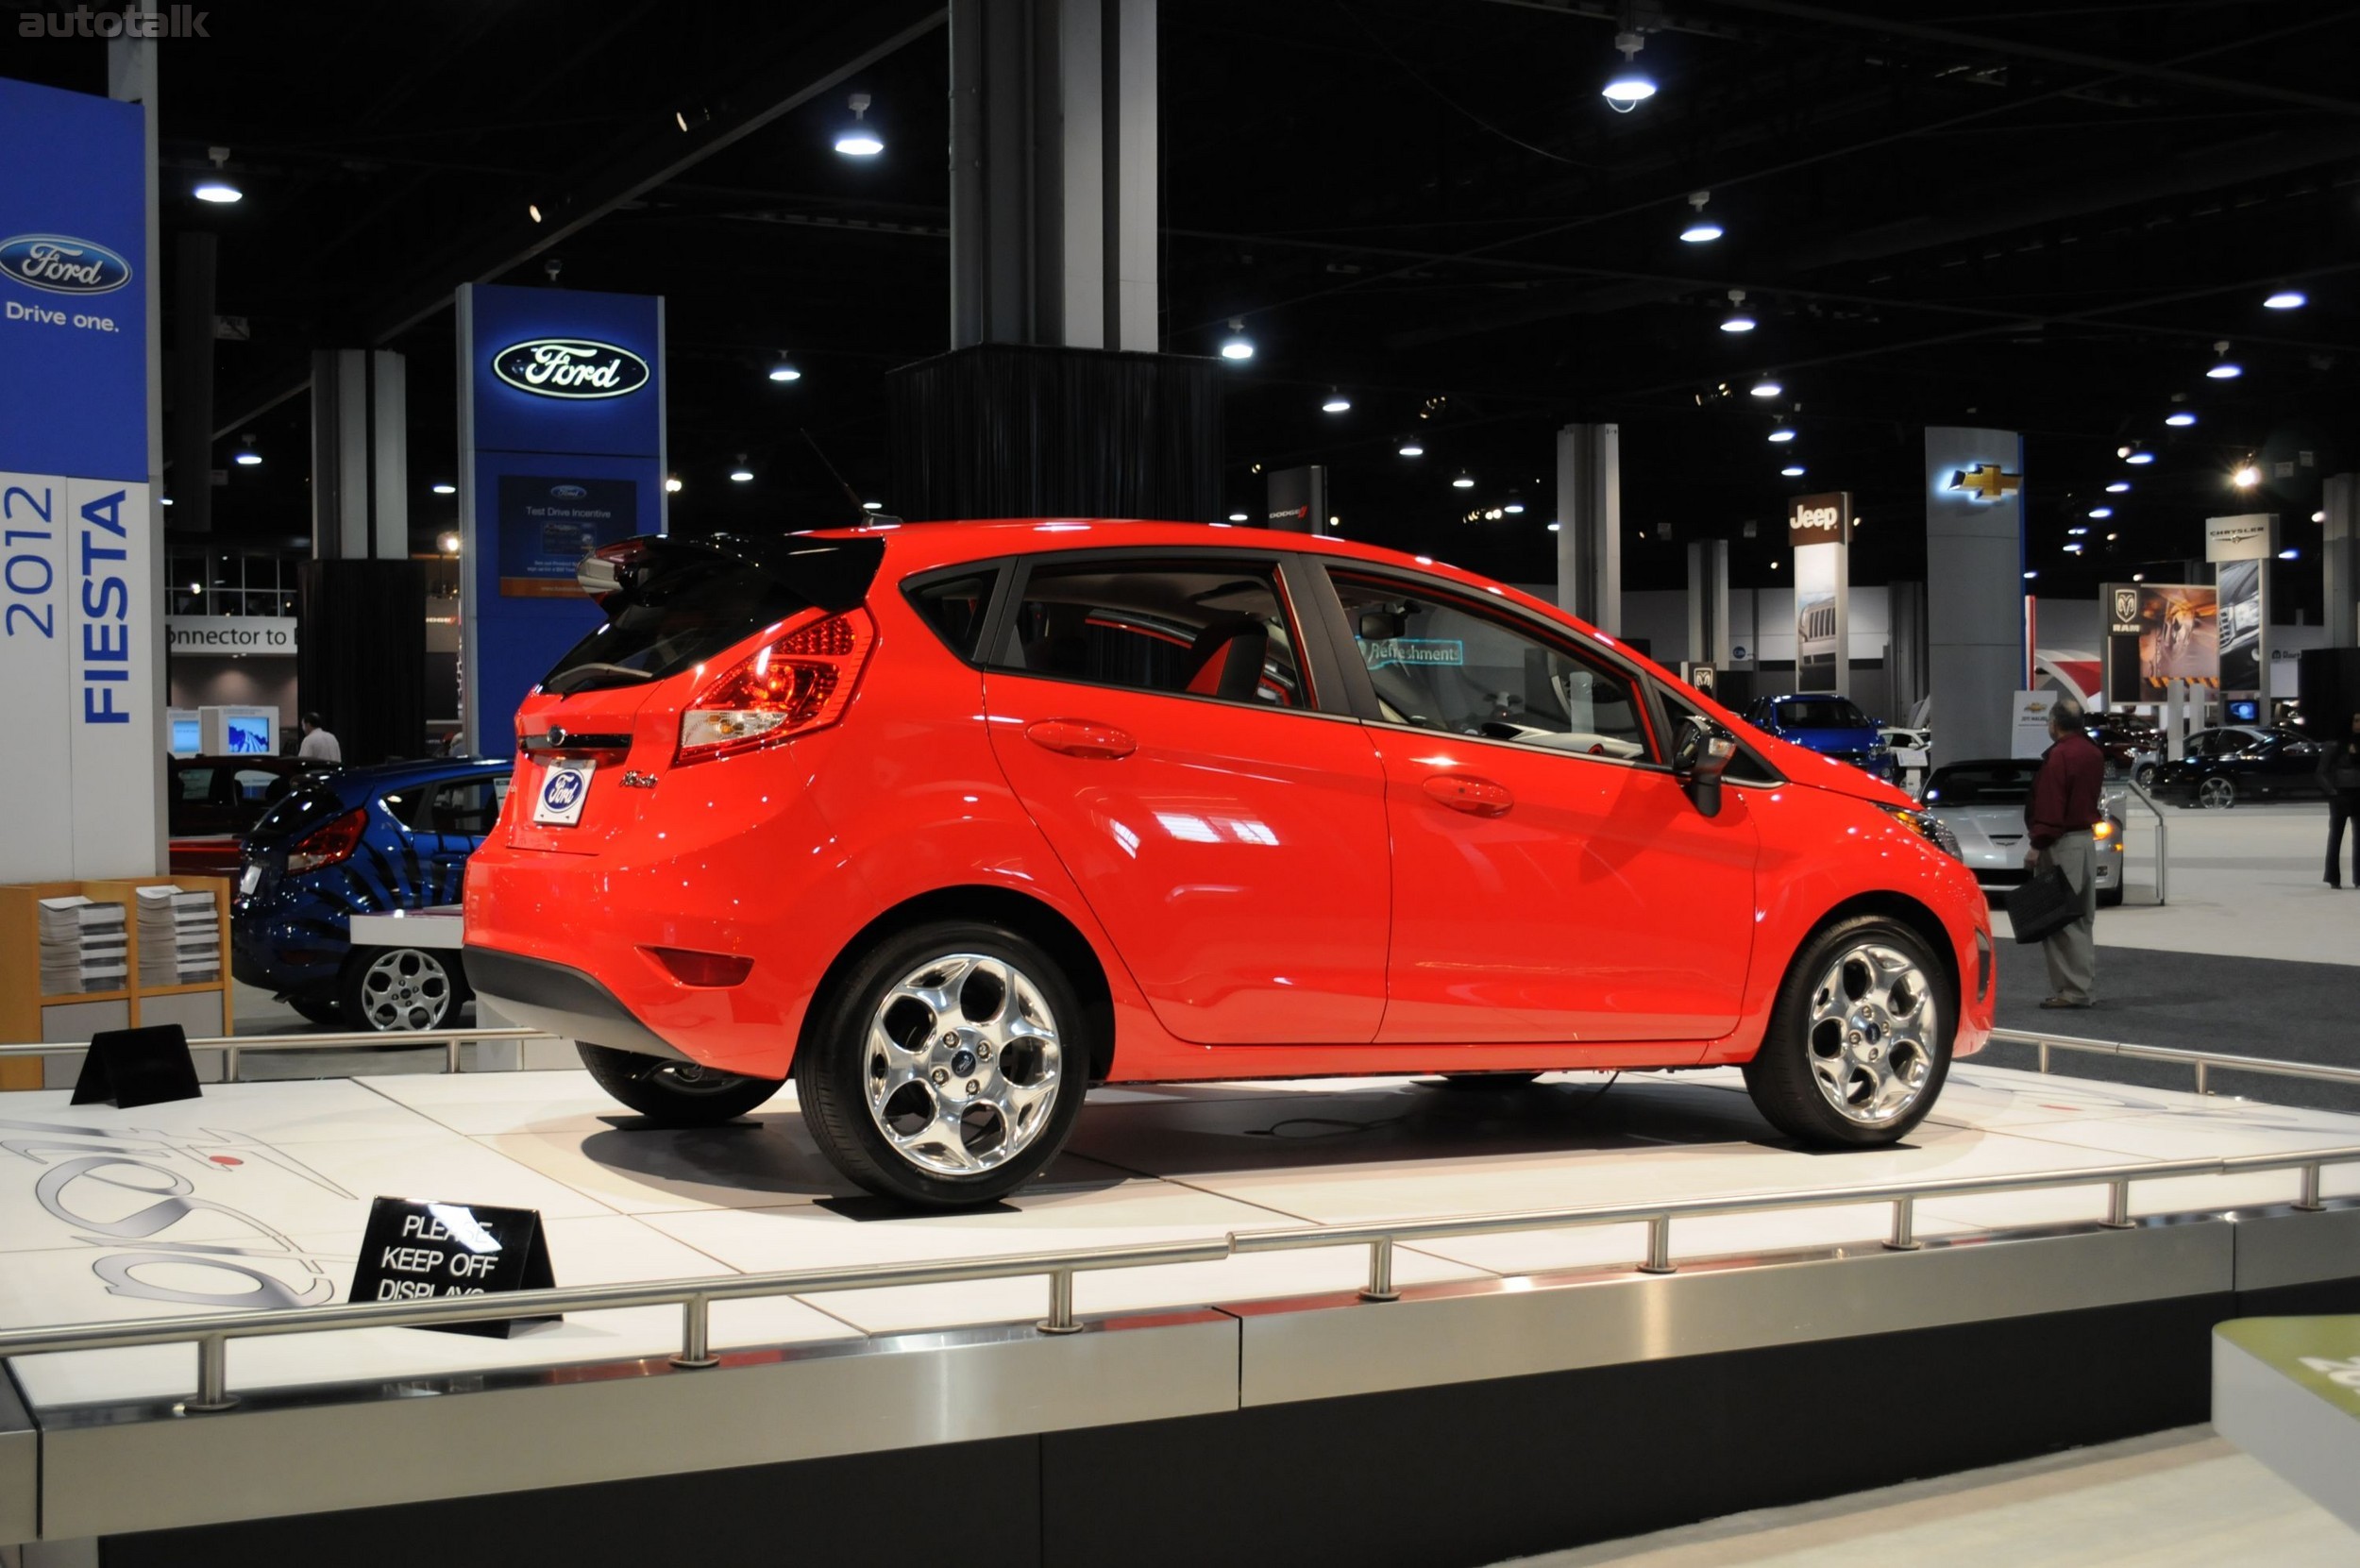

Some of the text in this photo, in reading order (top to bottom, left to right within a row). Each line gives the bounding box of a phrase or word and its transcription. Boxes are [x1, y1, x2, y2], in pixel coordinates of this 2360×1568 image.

[21, 243, 104, 285] Ford
[6, 300, 120, 333] Drive one.
[525, 345, 622, 389] Ford
[525, 506, 612, 518] Test Drive Incentive
[1269, 509, 1301, 519] DODGE
[1789, 504, 1838, 531] Jeep
[2209, 527, 2265, 536] CHRYSLER
[4, 486, 54, 639] 2012
[80, 489, 130, 724] FIESTA
[265, 629, 287, 645] to
[2113, 624, 2140, 632] RAM
[380, 1245, 499, 1279] KEEP OFF
[377, 1278, 485, 1301] DISPL
